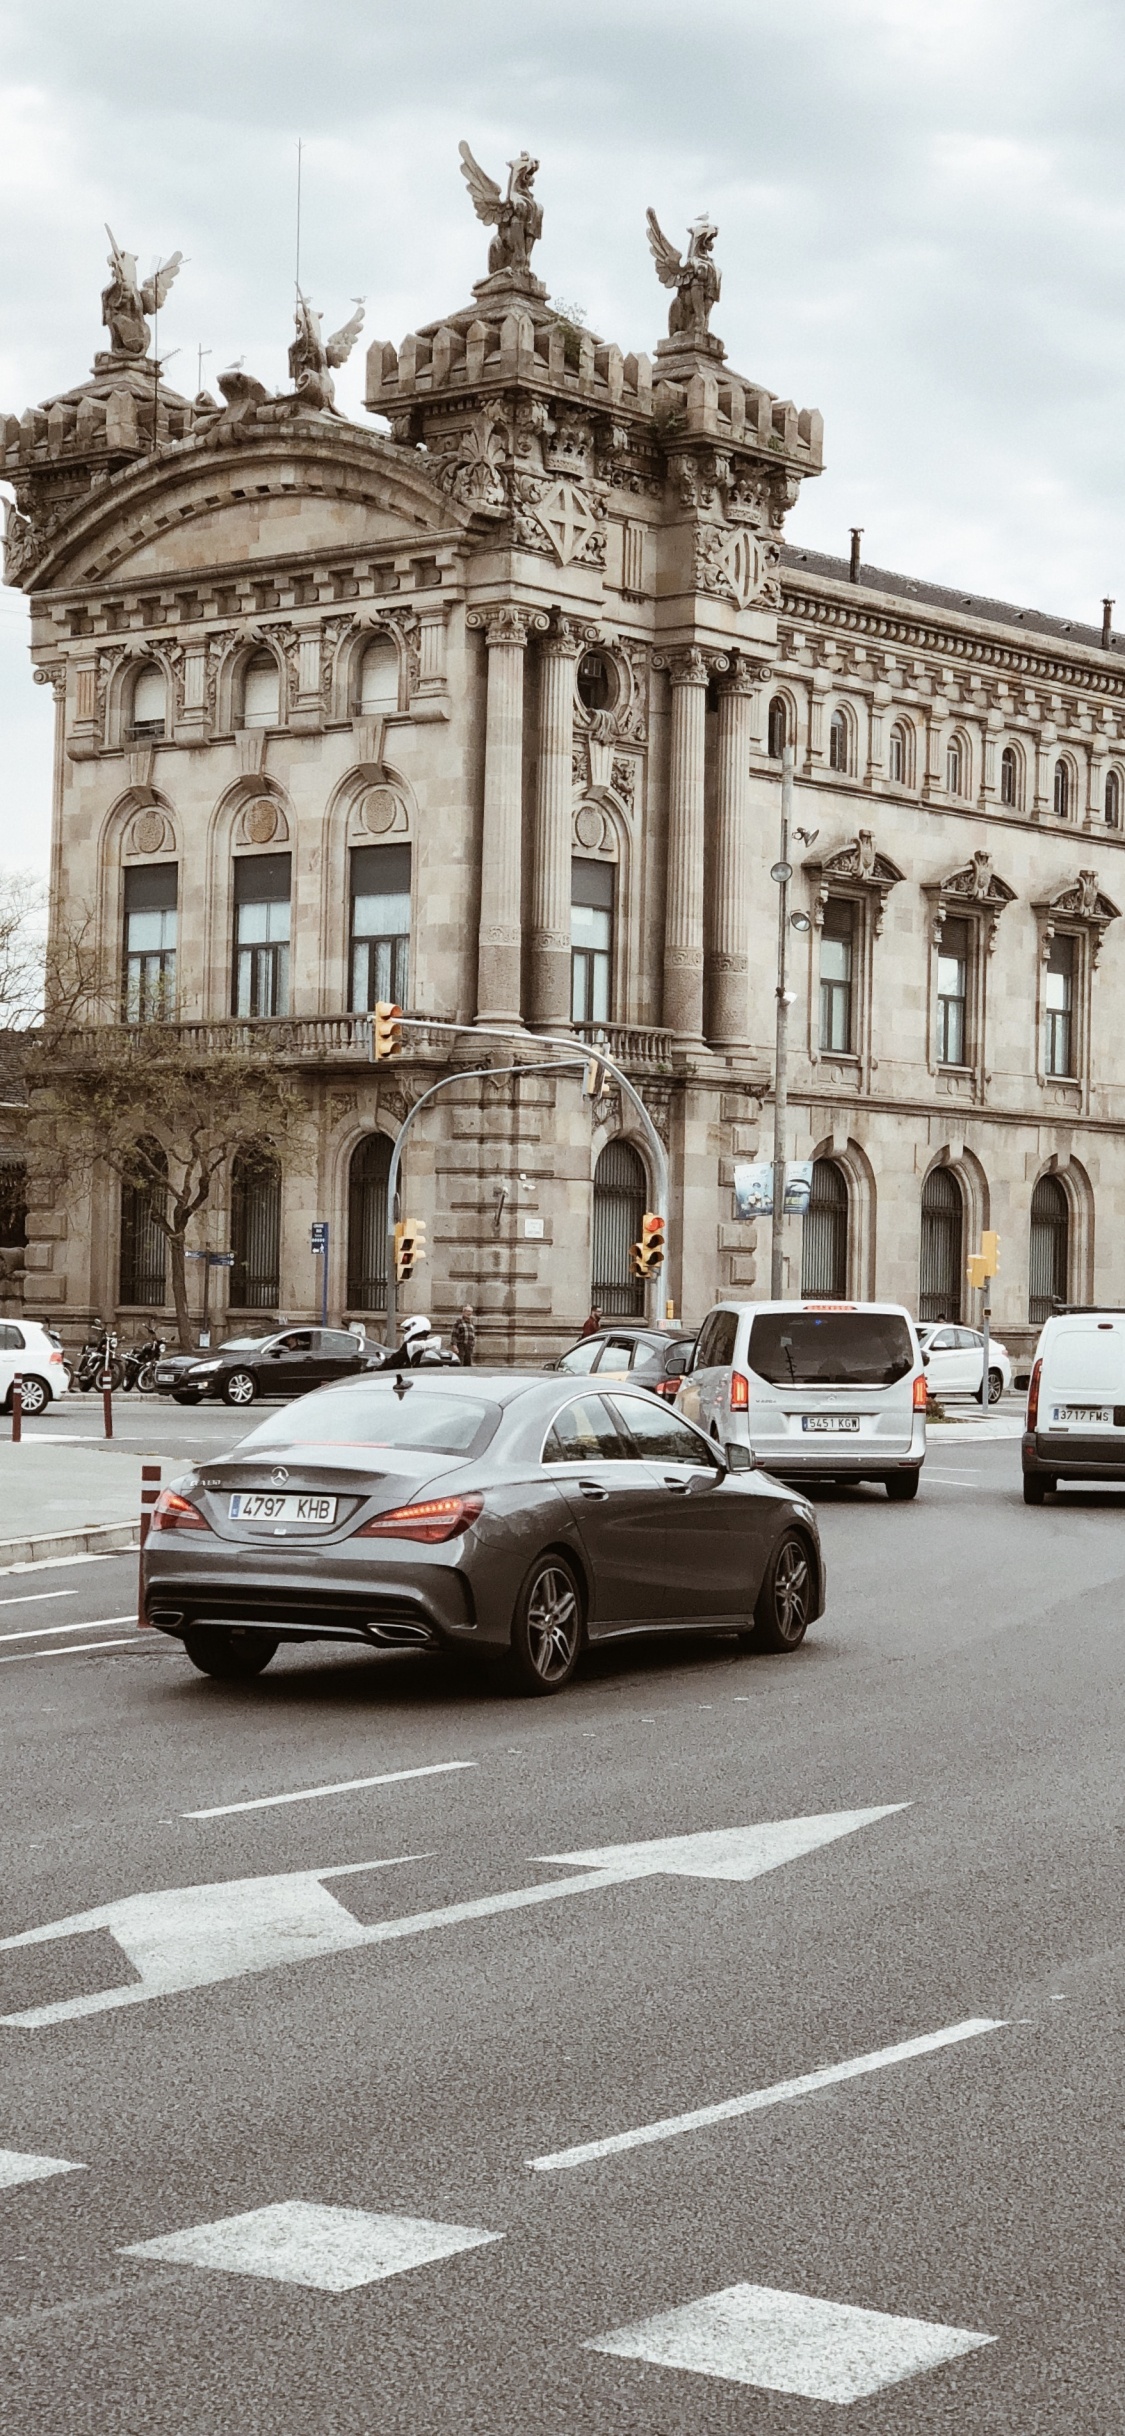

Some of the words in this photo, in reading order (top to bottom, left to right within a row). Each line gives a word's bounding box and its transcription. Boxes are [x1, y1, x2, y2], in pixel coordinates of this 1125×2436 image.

[1060, 1410, 1086, 1421] 3717
[809, 1418, 834, 1428] 5451
[243, 1497, 286, 1518] 4797
[297, 1498, 330, 1519] KHB
